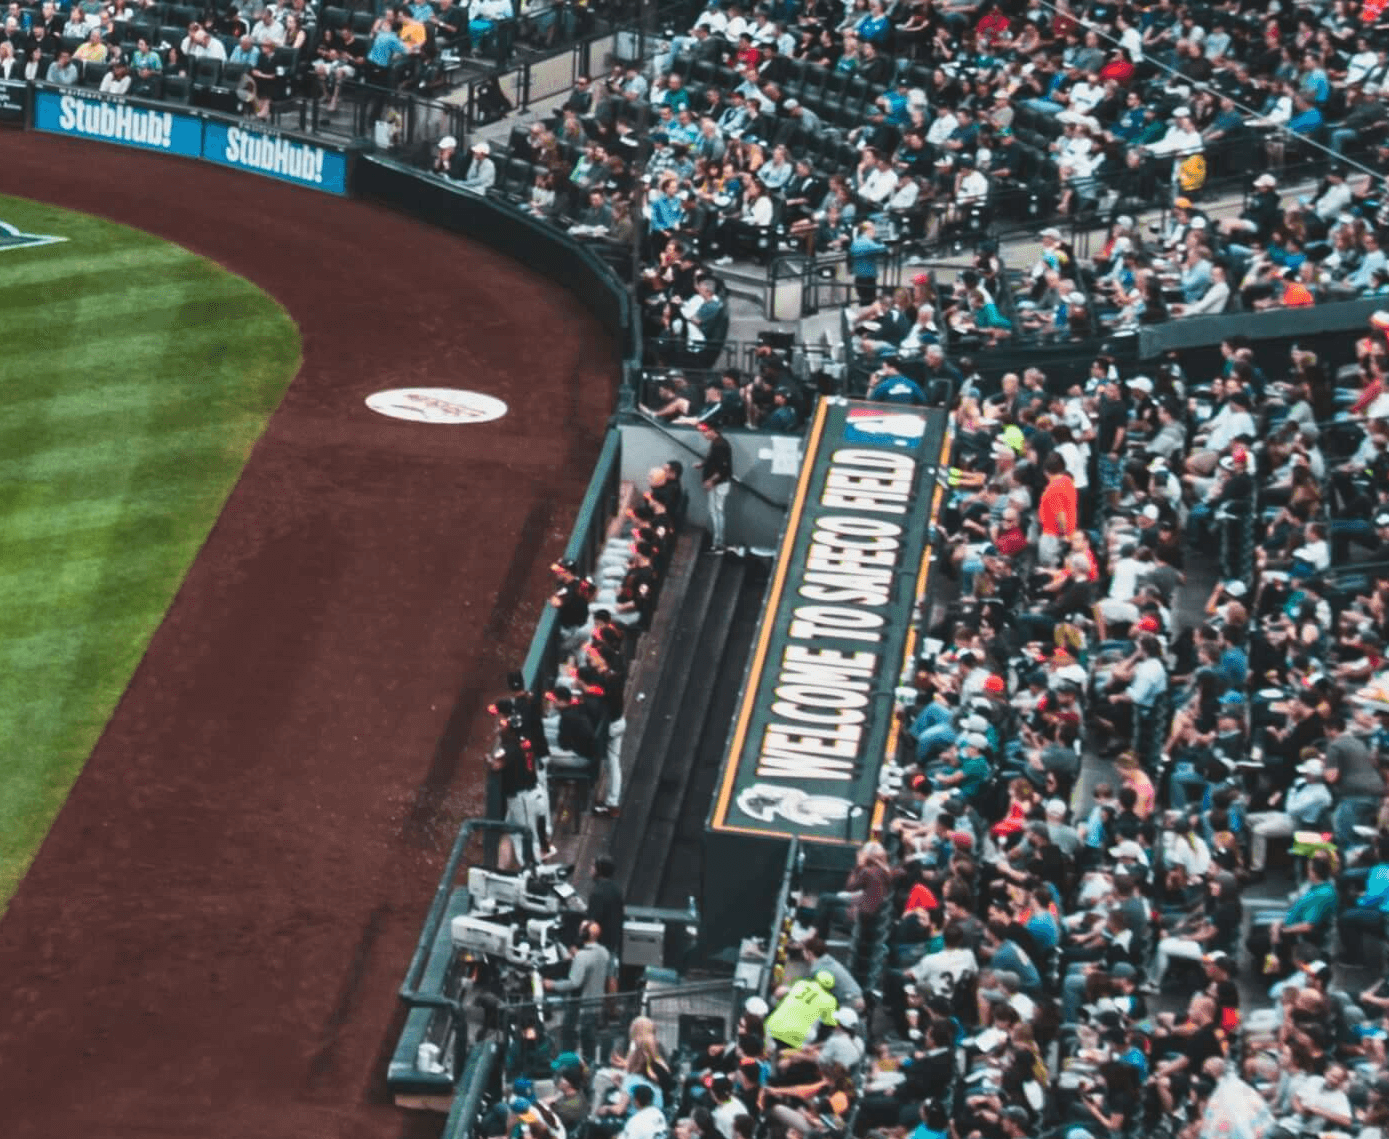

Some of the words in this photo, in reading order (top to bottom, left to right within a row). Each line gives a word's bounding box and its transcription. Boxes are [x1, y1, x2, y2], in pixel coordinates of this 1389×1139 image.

[59, 95, 172, 148] StubHub!
[225, 126, 323, 183] StubHub!
[820, 448, 915, 514] FIELD
[798, 516, 902, 606] SAFECO
[788, 605, 884, 642] TO
[757, 645, 876, 780] WELCOME
